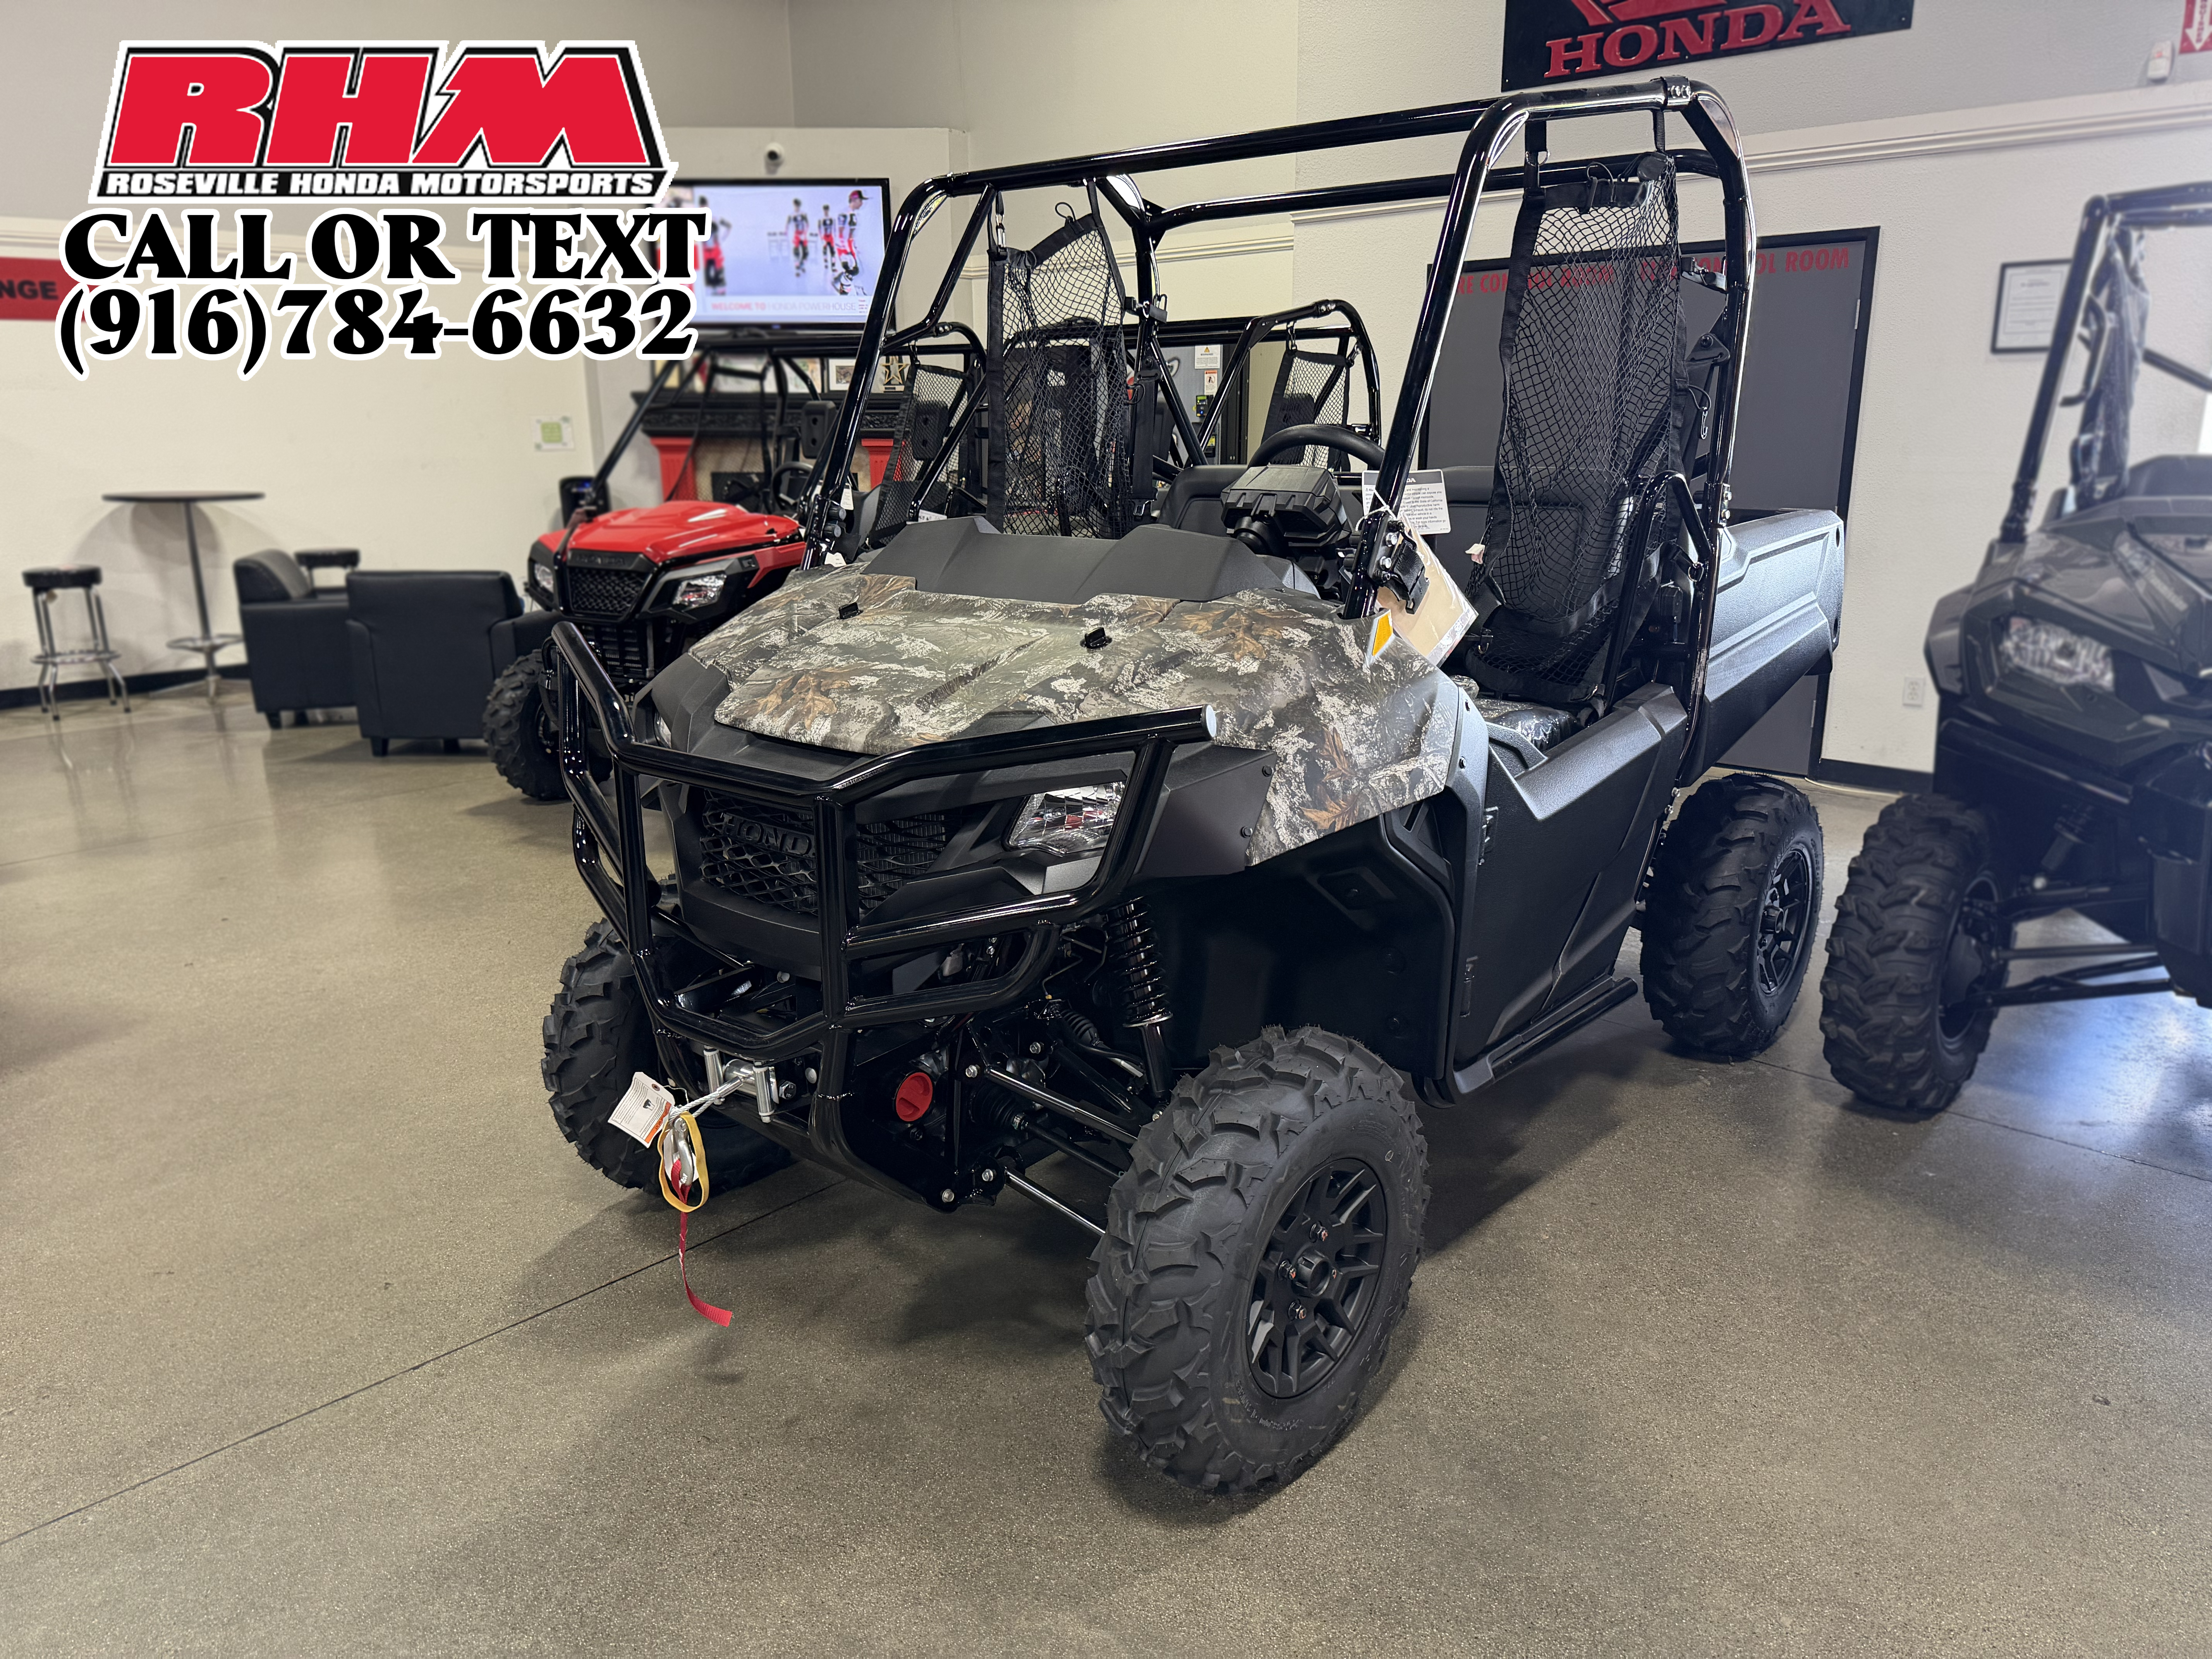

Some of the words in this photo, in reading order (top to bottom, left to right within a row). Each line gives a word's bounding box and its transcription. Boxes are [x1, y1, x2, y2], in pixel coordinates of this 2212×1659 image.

[1544, 0, 1851, 77] HONDA
[1695, 253, 1776, 275] ONOL
[1785, 247, 1849, 273] ROOM
[0, 279, 59, 300] NGE
[1480, 268, 1552, 293] COOL
[711, 302, 751, 310] WELCOME
[799, 302, 856, 310] POWERHOUSE
[723, 812, 816, 857] HOND
